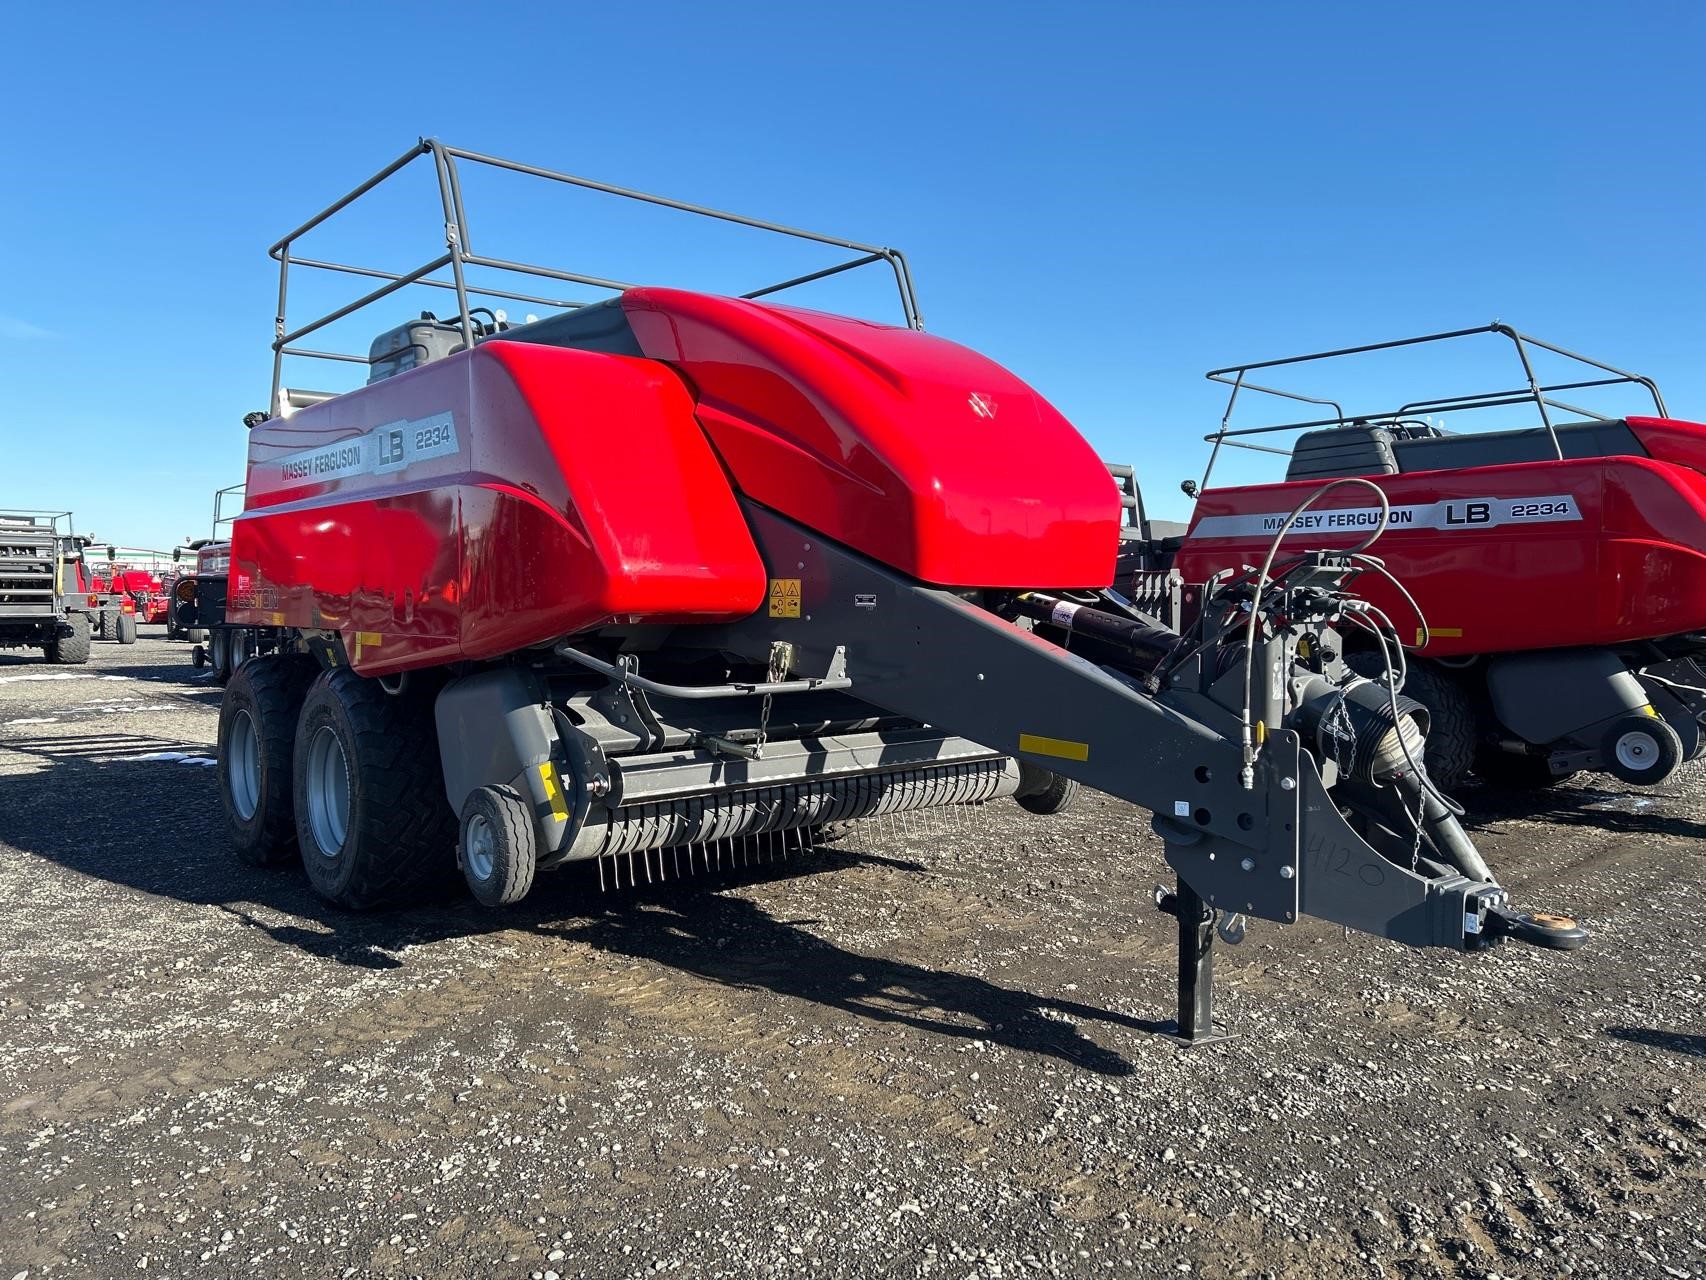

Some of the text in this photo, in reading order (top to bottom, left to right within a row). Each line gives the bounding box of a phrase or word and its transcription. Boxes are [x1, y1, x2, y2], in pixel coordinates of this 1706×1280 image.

[282, 424, 449, 481] MASSEY FERGUSON LB 2234
[1446, 503, 1490, 525] LB
[1511, 502, 1569, 517] 2234
[232, 588, 278, 609] HESSTON
